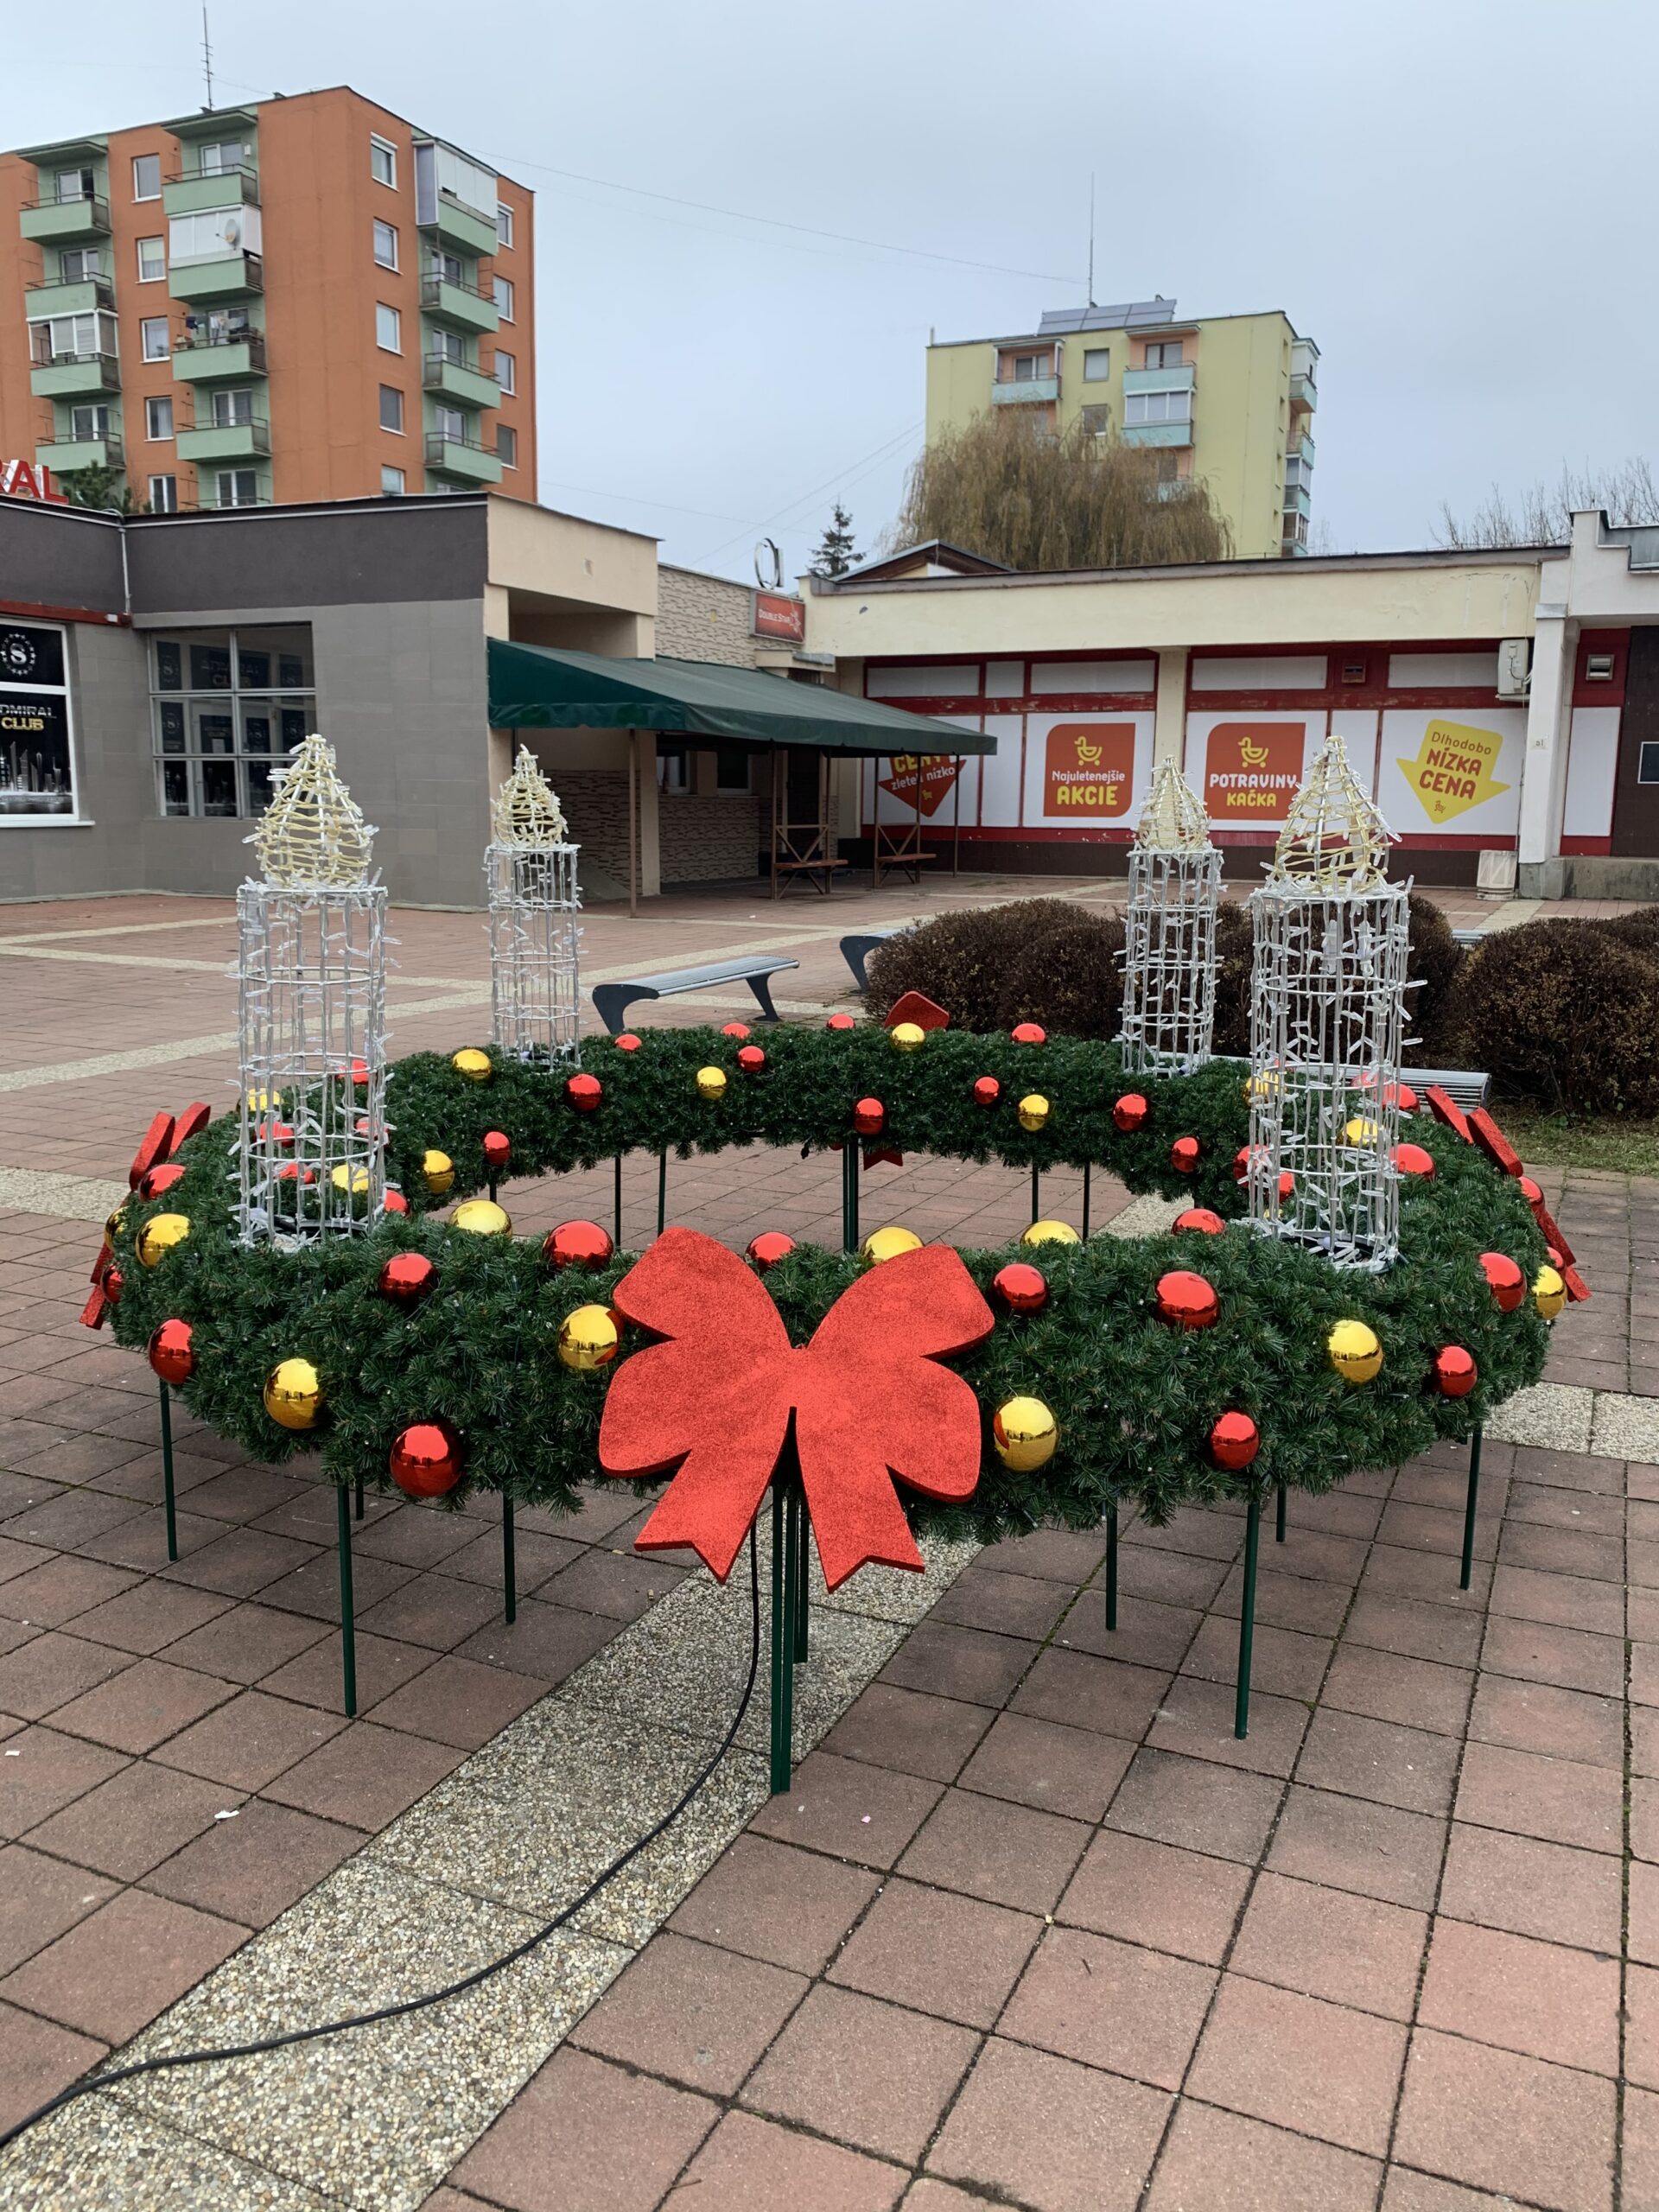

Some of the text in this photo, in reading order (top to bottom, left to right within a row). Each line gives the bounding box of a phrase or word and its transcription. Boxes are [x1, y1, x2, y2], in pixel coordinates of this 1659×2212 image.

[0, 458, 69, 505] AL
[10, 643, 28, 665] S
[0, 703, 57, 719] DMIRAL
[1, 716, 44, 731] CLUB
[1431, 731, 1491, 755] Dlhodobo
[1426, 747, 1482, 777] NÍZKA
[1052, 770, 1125, 785] Najuletenejšie
[1210, 773, 1296, 789] POTRAVINY
[1419, 769, 1476, 800] CENA
[1057, 785, 1118, 805] AKCIE
[1226, 789, 1277, 807] KAČKA
